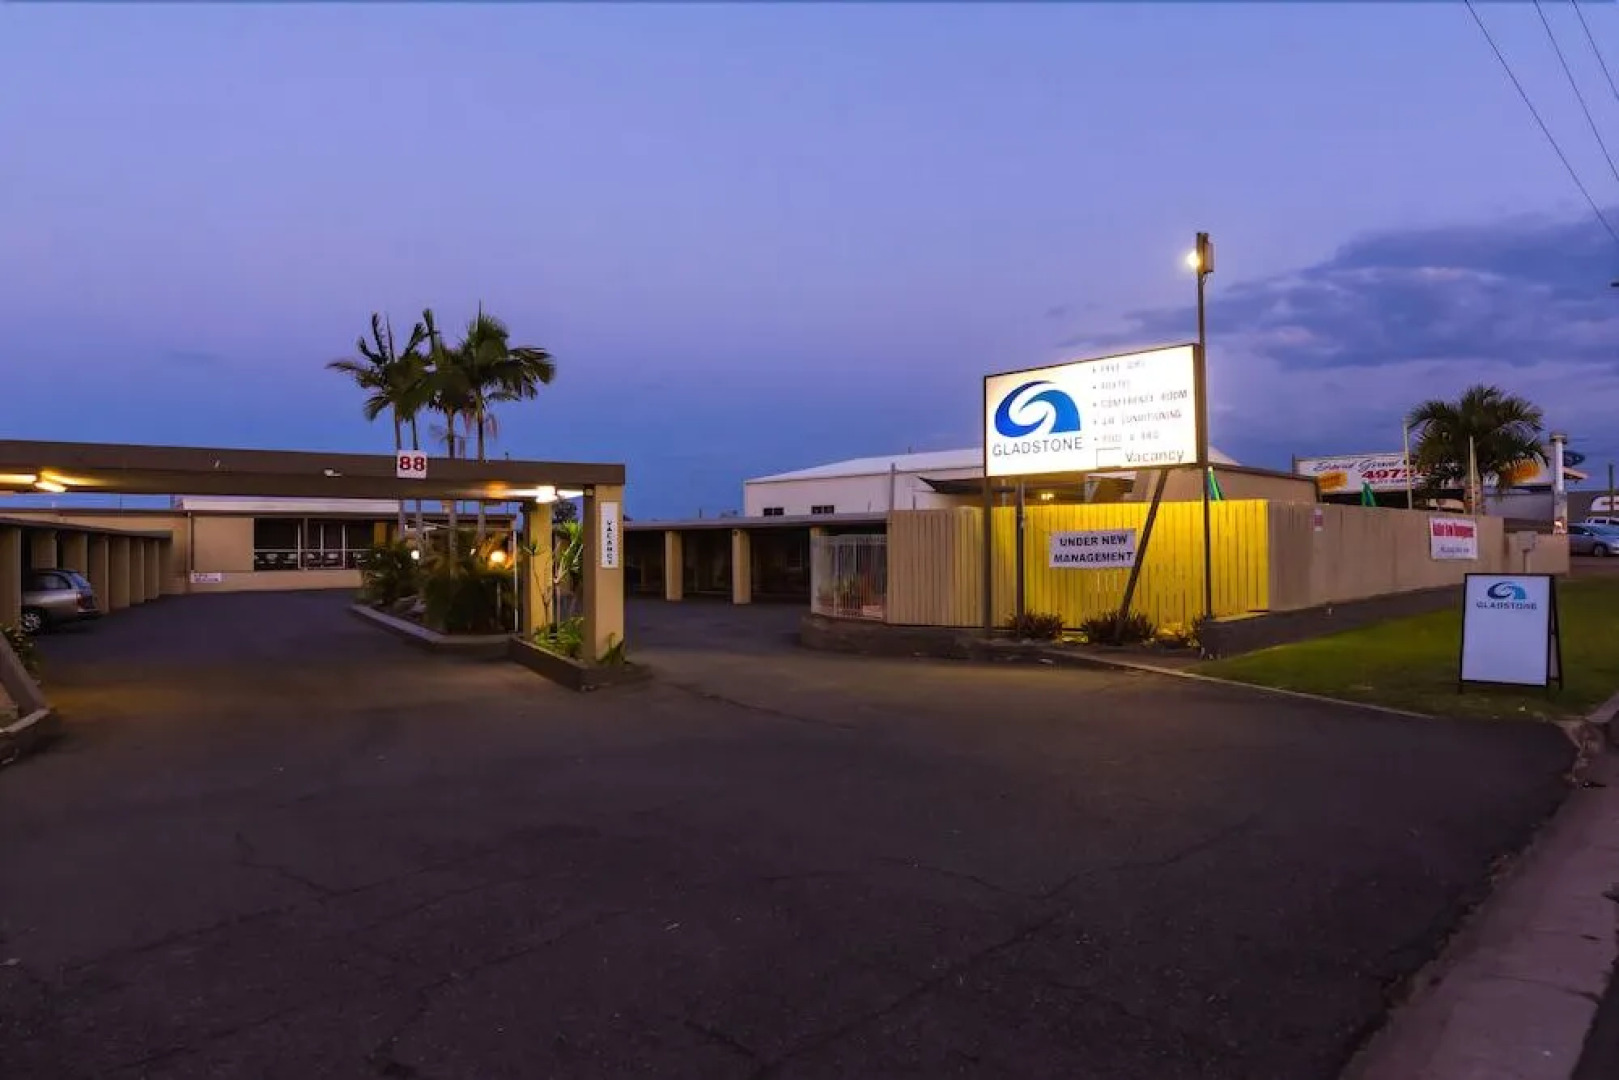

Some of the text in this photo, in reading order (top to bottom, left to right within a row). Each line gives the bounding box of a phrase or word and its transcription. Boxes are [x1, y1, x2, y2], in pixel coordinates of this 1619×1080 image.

[992, 436, 1084, 457] GLADSTONE
[1125, 449, 1184, 463] Vacancy
[400, 456, 425, 471] 88
[1060, 534, 1128, 547] UNDER NEW
[1053, 551, 1133, 563] MANAGEMENT
[1476, 600, 1537, 610] GLADSTONE
